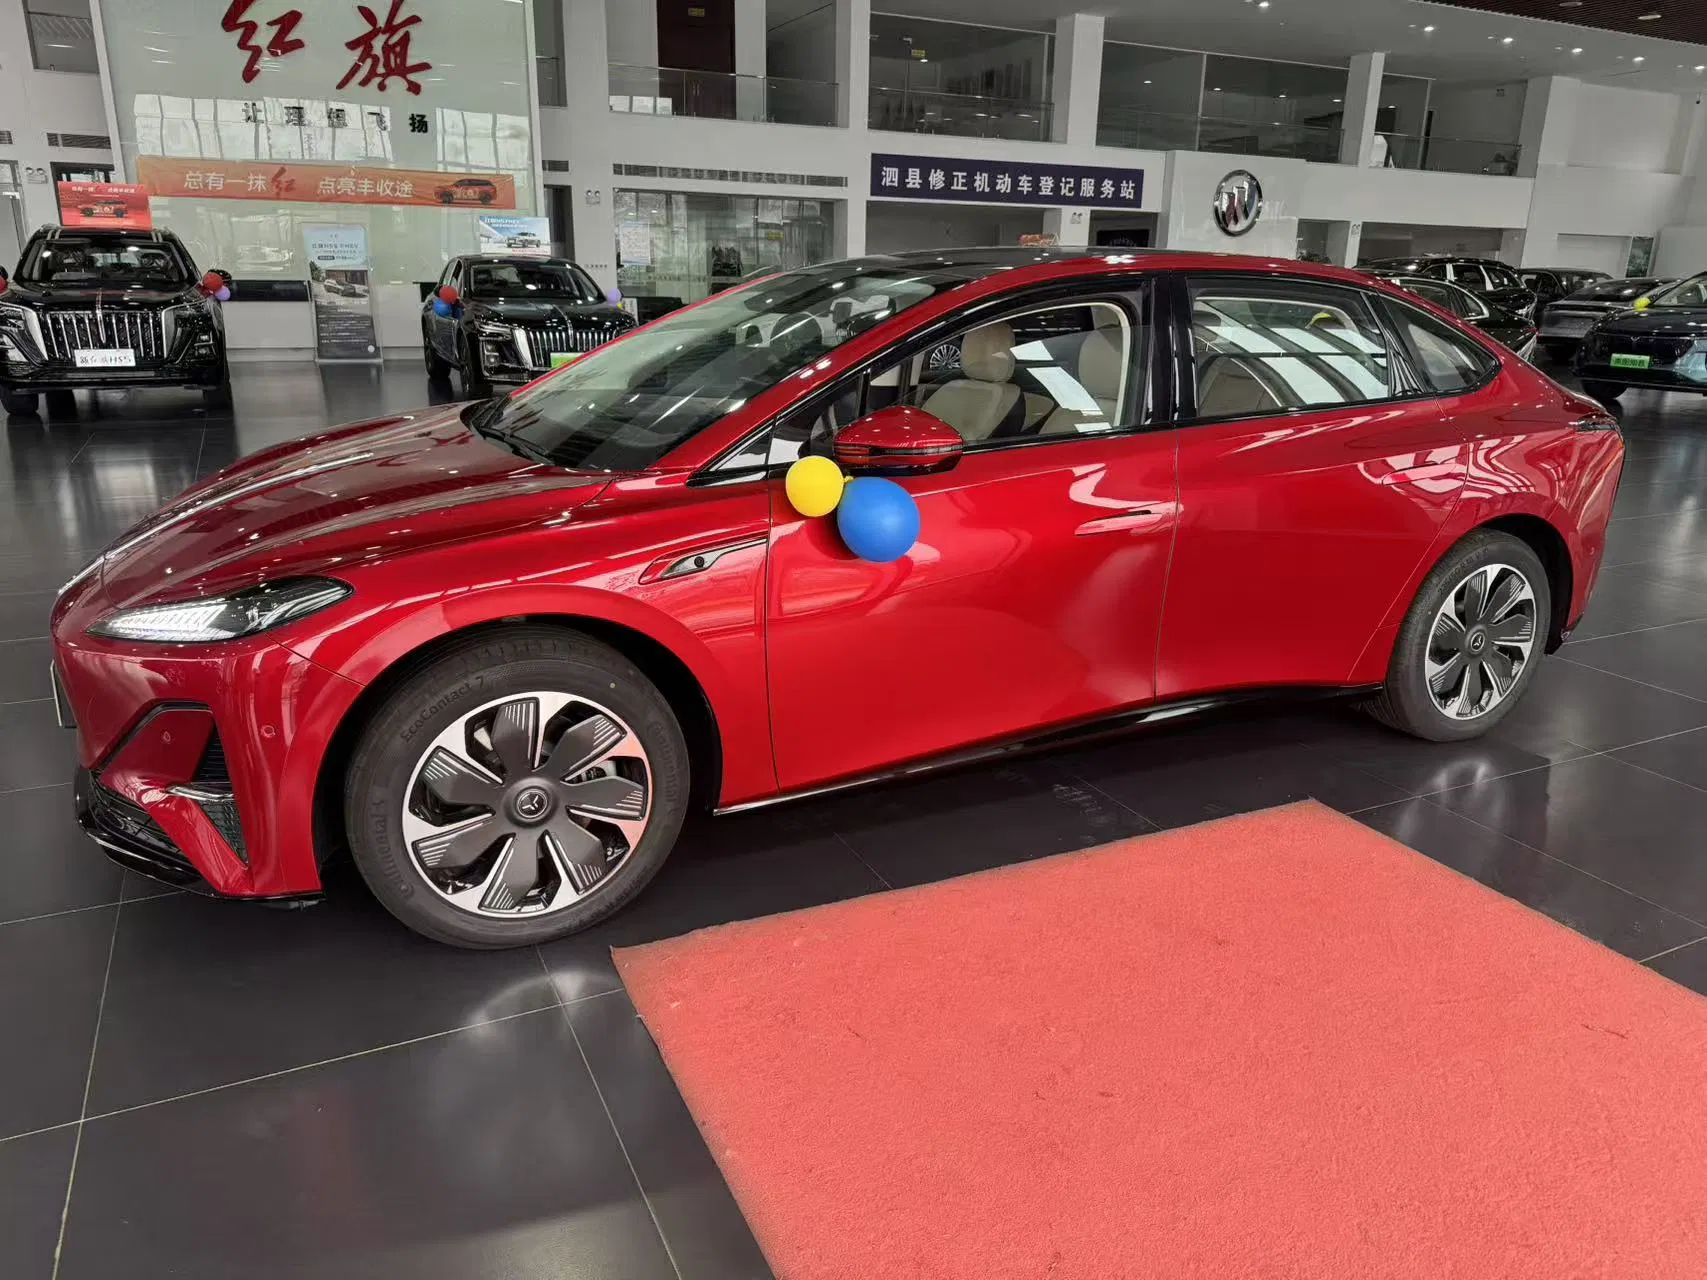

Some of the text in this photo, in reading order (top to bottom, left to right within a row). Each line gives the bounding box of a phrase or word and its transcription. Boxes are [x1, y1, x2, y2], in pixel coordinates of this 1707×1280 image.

[221, 0, 433, 96] 红旗
[183, 166, 416, 199] 总有一抹红 点亮丰收途
[880, 166, 1136, 200] 泗县修正机动车登记服务站
[401, 676, 484, 742] EcoContact 7
